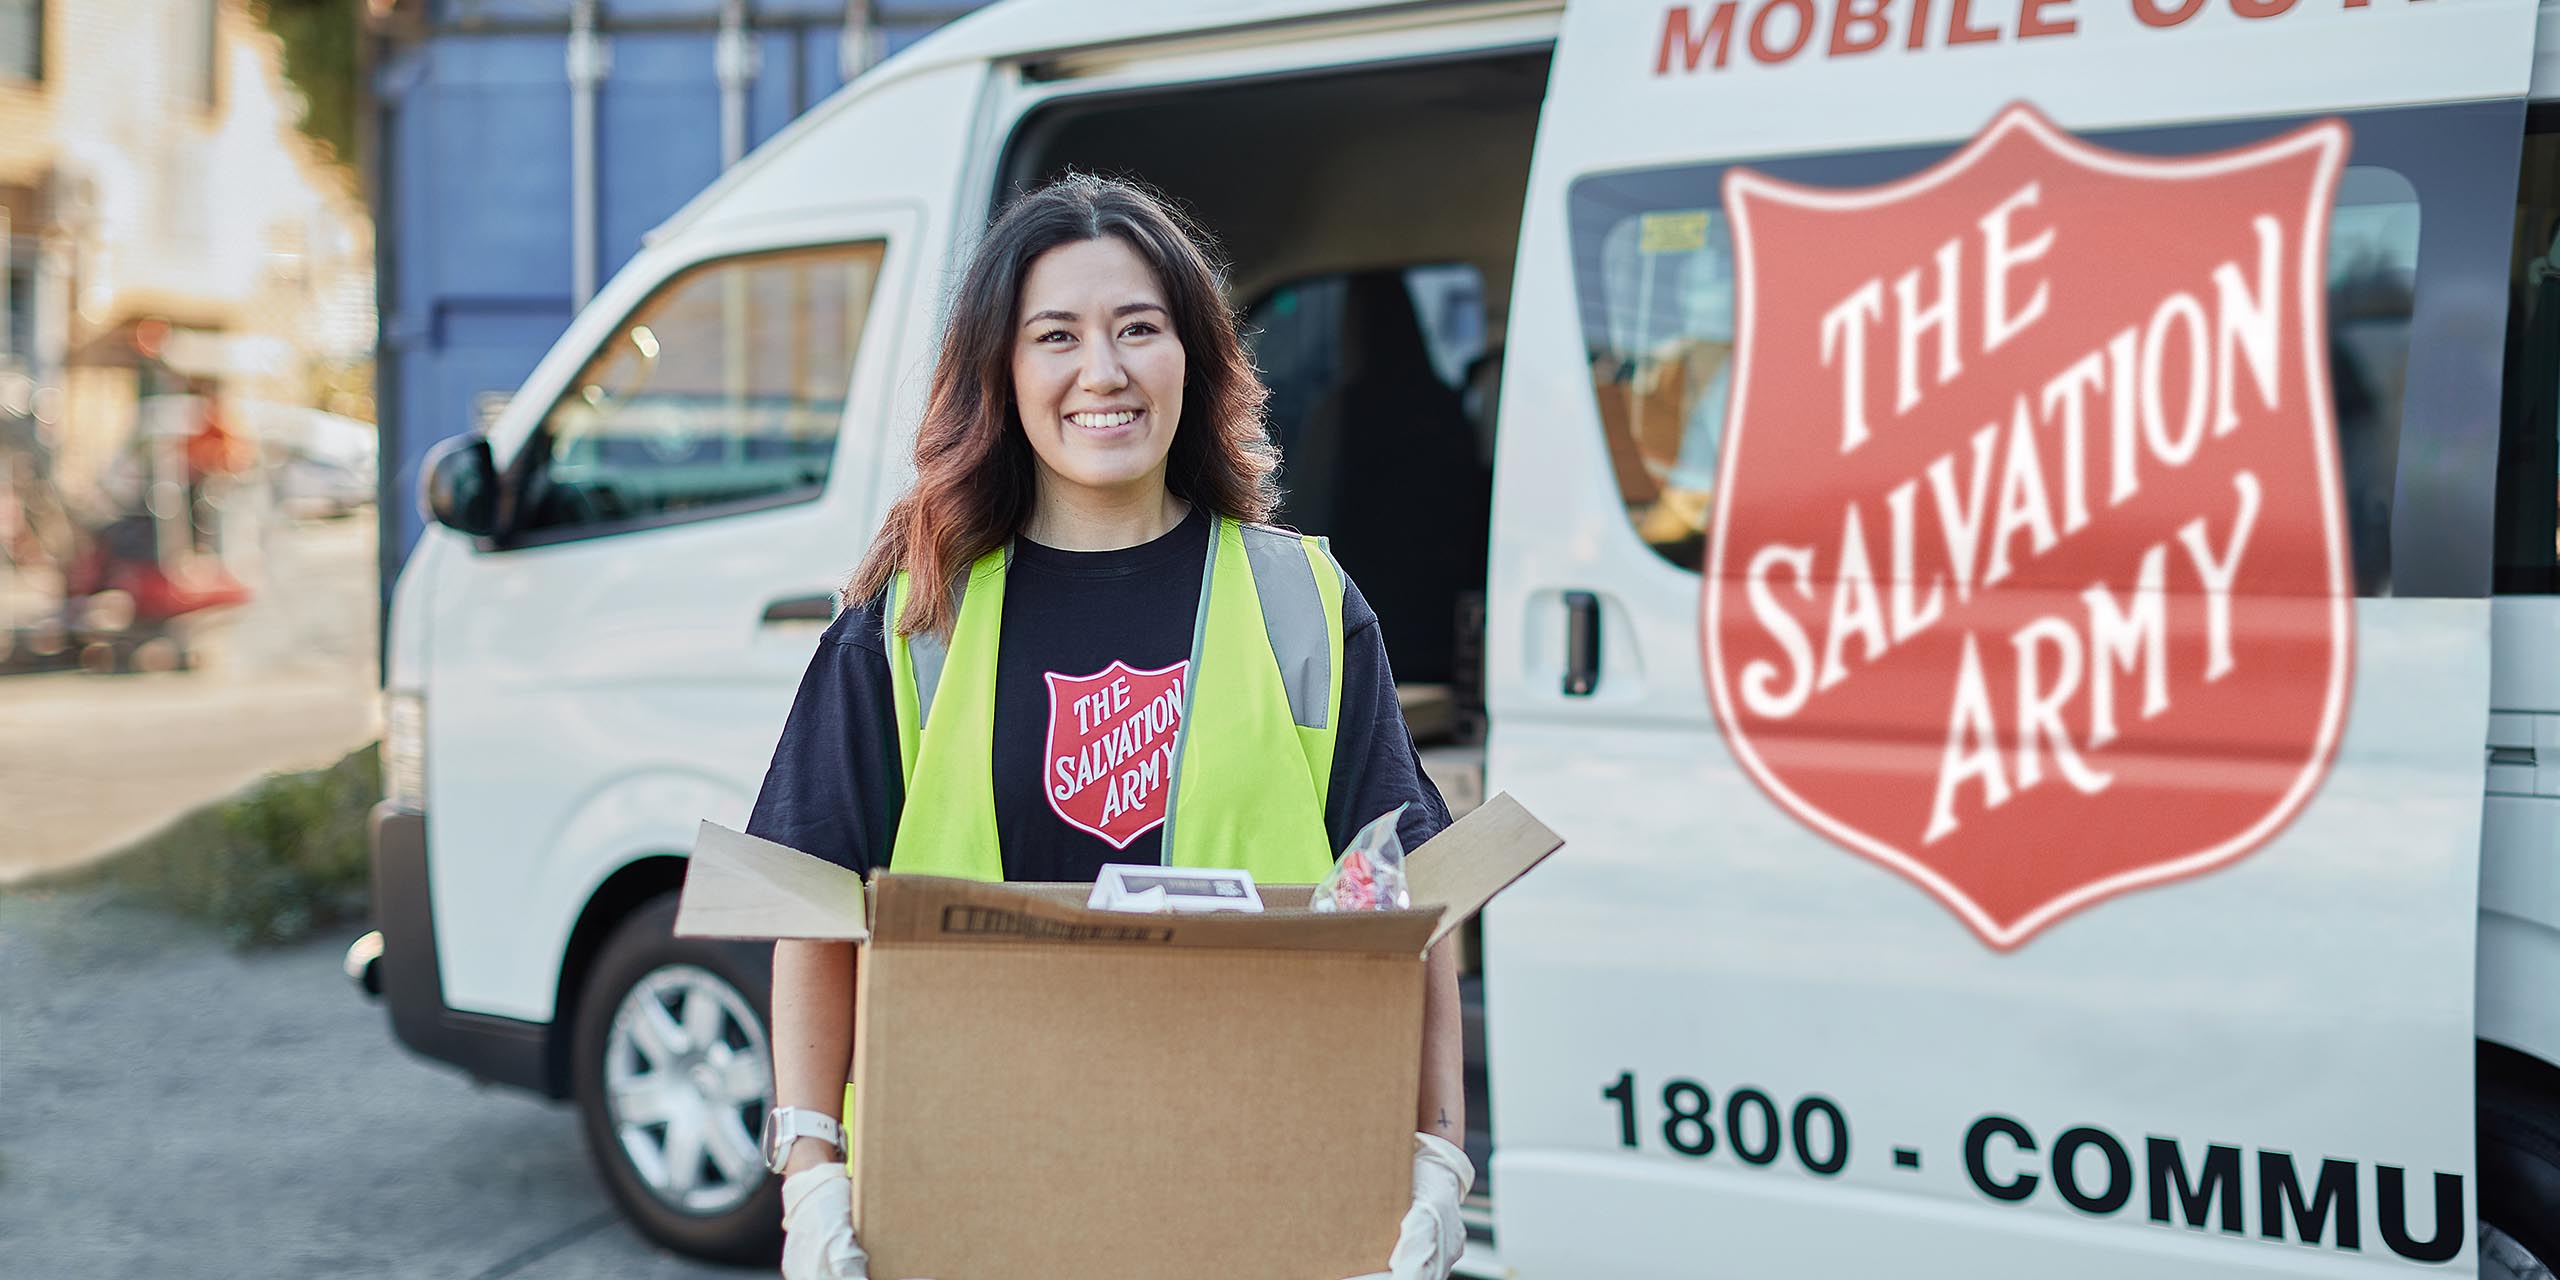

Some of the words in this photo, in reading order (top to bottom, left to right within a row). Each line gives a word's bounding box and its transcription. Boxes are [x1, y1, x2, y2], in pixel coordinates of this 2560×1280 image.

[1656, 0, 2077, 74] MOBILE
[1820, 181, 2056, 454] THE
[1740, 214, 2282, 718] SALVATION
[1055, 678, 1182, 800] SALVATION
[1073, 676, 1131, 735] THE
[1923, 471, 2262, 845] ARMY
[1603, 1071, 1850, 1175] 1800
[1894, 1148, 1921, 1169] -
[1964, 1116, 2465, 1264] COMMU
